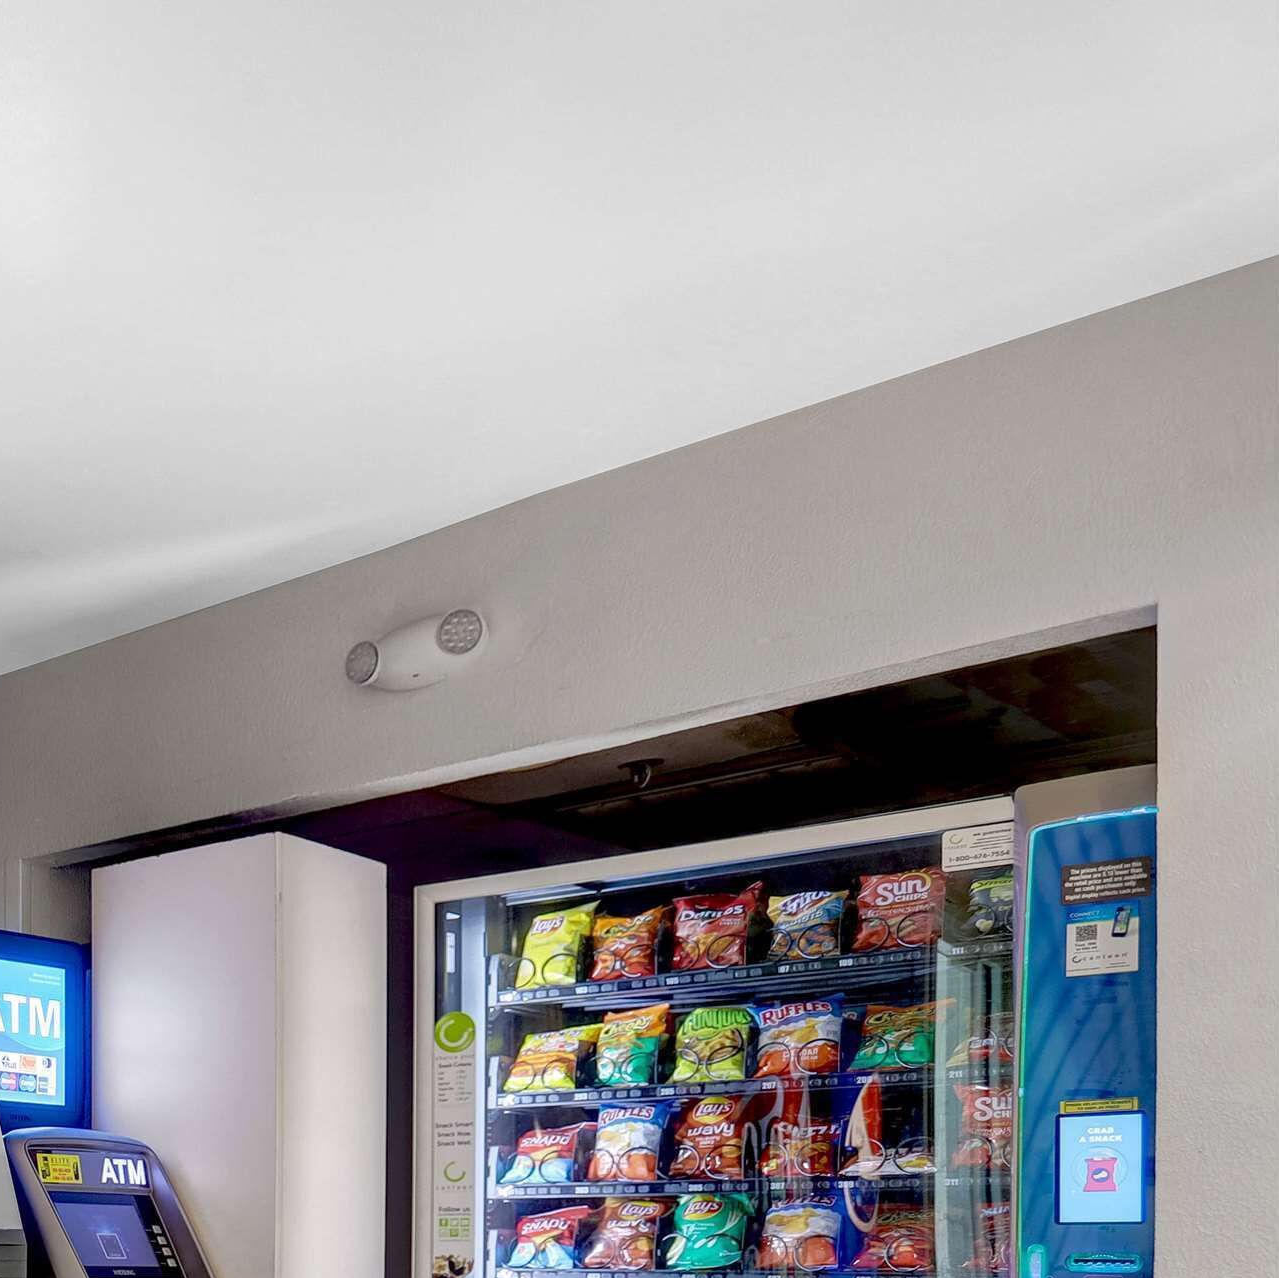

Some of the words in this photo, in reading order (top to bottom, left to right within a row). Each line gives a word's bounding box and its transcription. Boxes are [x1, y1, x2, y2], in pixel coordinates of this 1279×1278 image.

[875, 879, 928, 906] Sun
[894, 891, 928, 903] CHIPS
[680, 905, 745, 923] Doritos
[760, 1001, 833, 1027] RUFFLES
[687, 1122, 735, 1137] wavy
[1087, 1126, 1114, 1135] GRAB
[1089, 1135, 1123, 1143] SNACK
[101, 1157, 147, 1185] ATM
